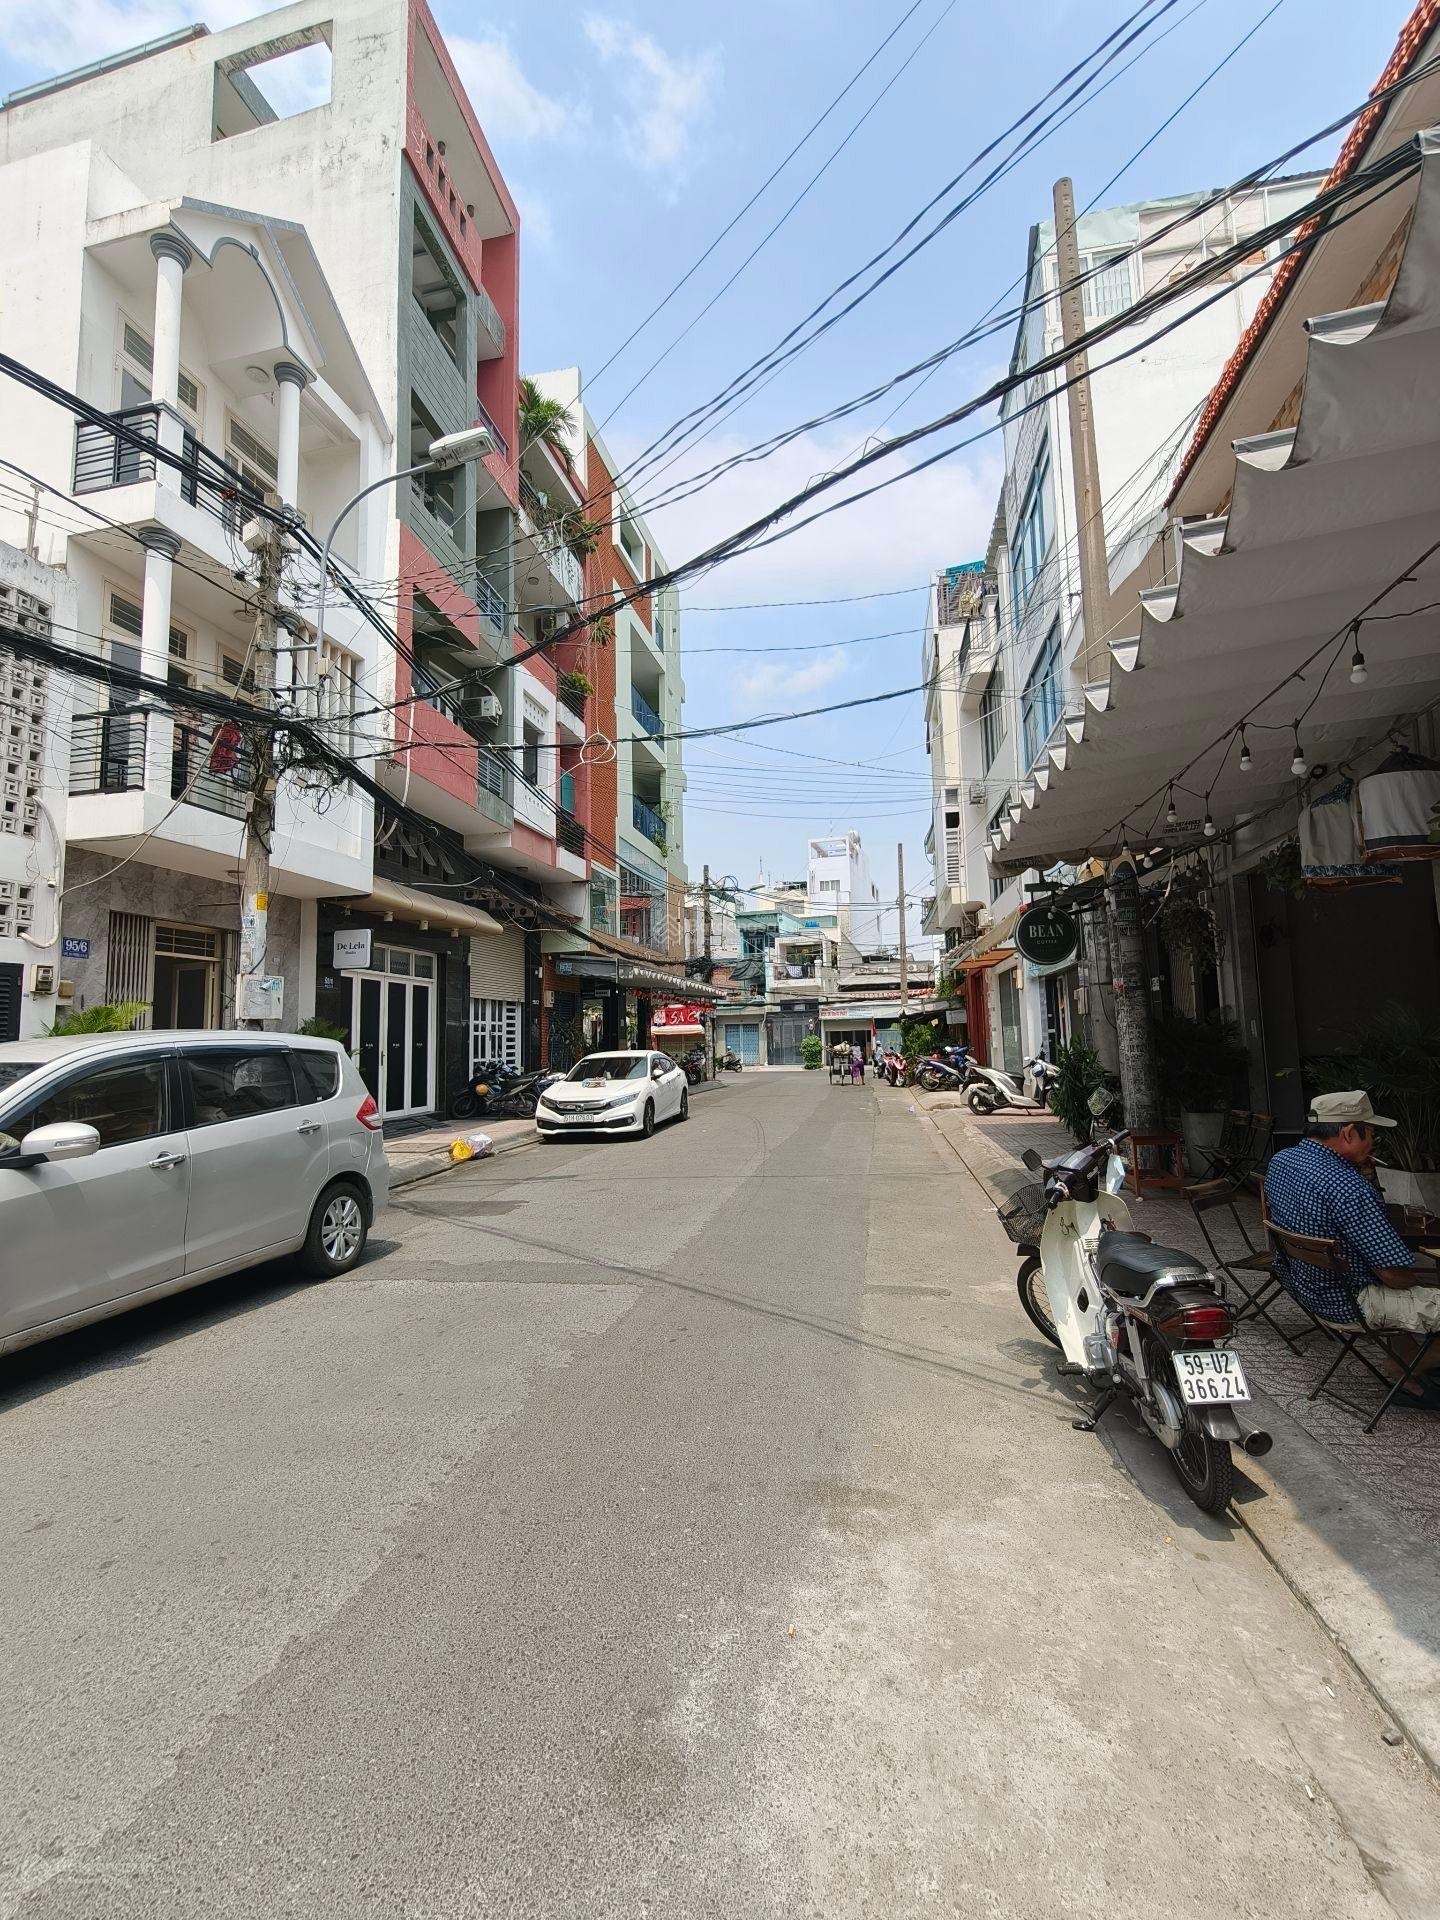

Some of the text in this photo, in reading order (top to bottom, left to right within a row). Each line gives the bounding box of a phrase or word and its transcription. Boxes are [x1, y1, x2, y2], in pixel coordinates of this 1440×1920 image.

[1029, 924, 1064, 938] BEAN
[65, 939, 88, 952] 95/6
[337, 941, 366, 951] De Lela
[1183, 1353, 1233, 1375] 59-U2
[1184, 1376, 1245, 1400] 366.24
